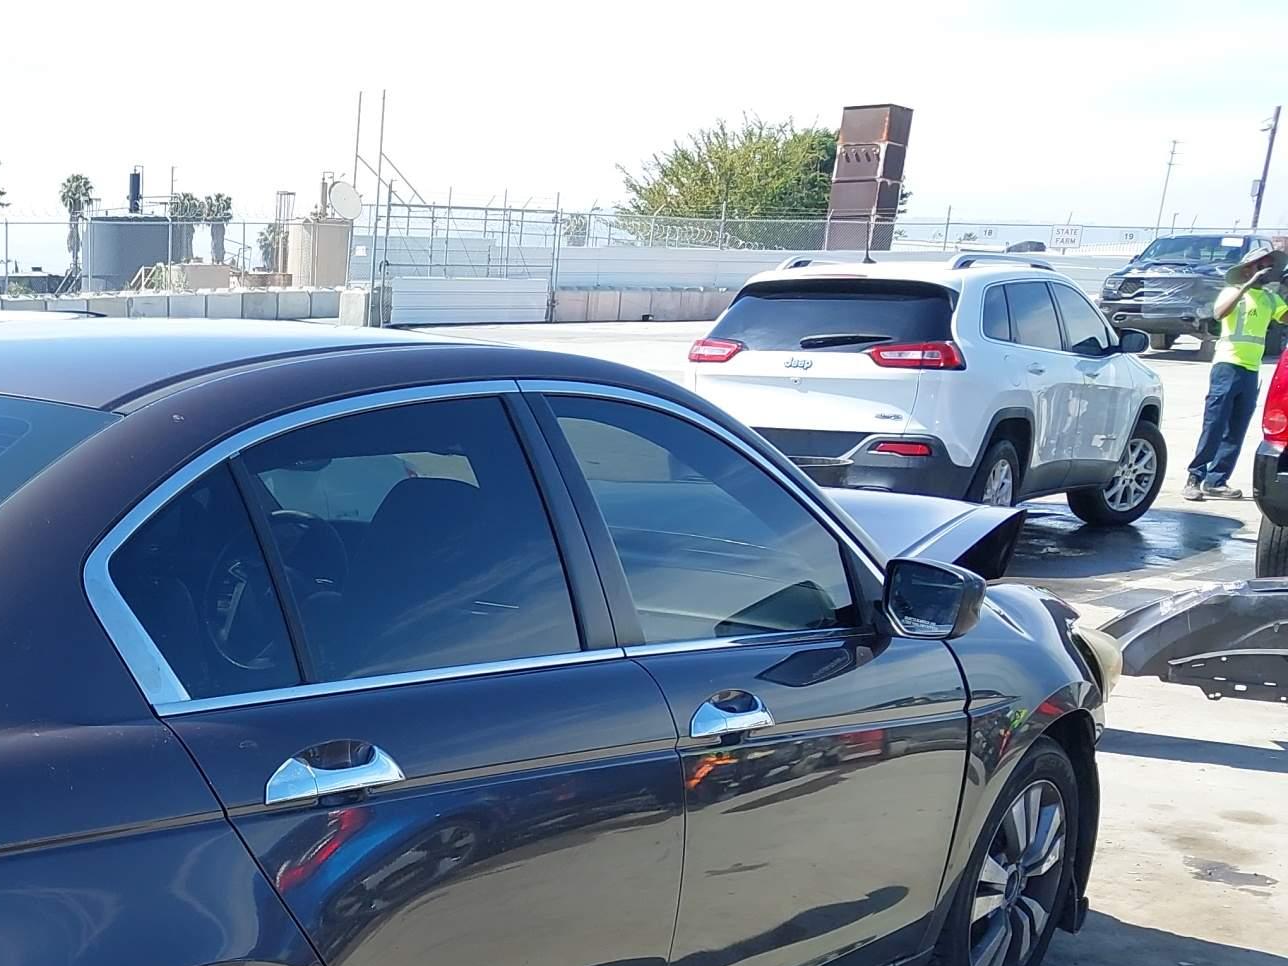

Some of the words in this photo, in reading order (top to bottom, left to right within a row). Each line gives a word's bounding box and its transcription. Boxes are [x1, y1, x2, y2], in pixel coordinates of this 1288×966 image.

[1055, 228, 1079, 236] STATE
[1124, 232, 1134, 240] 19
[1055, 237, 1076, 245] FARM
[784, 357, 813, 370] Jeep
